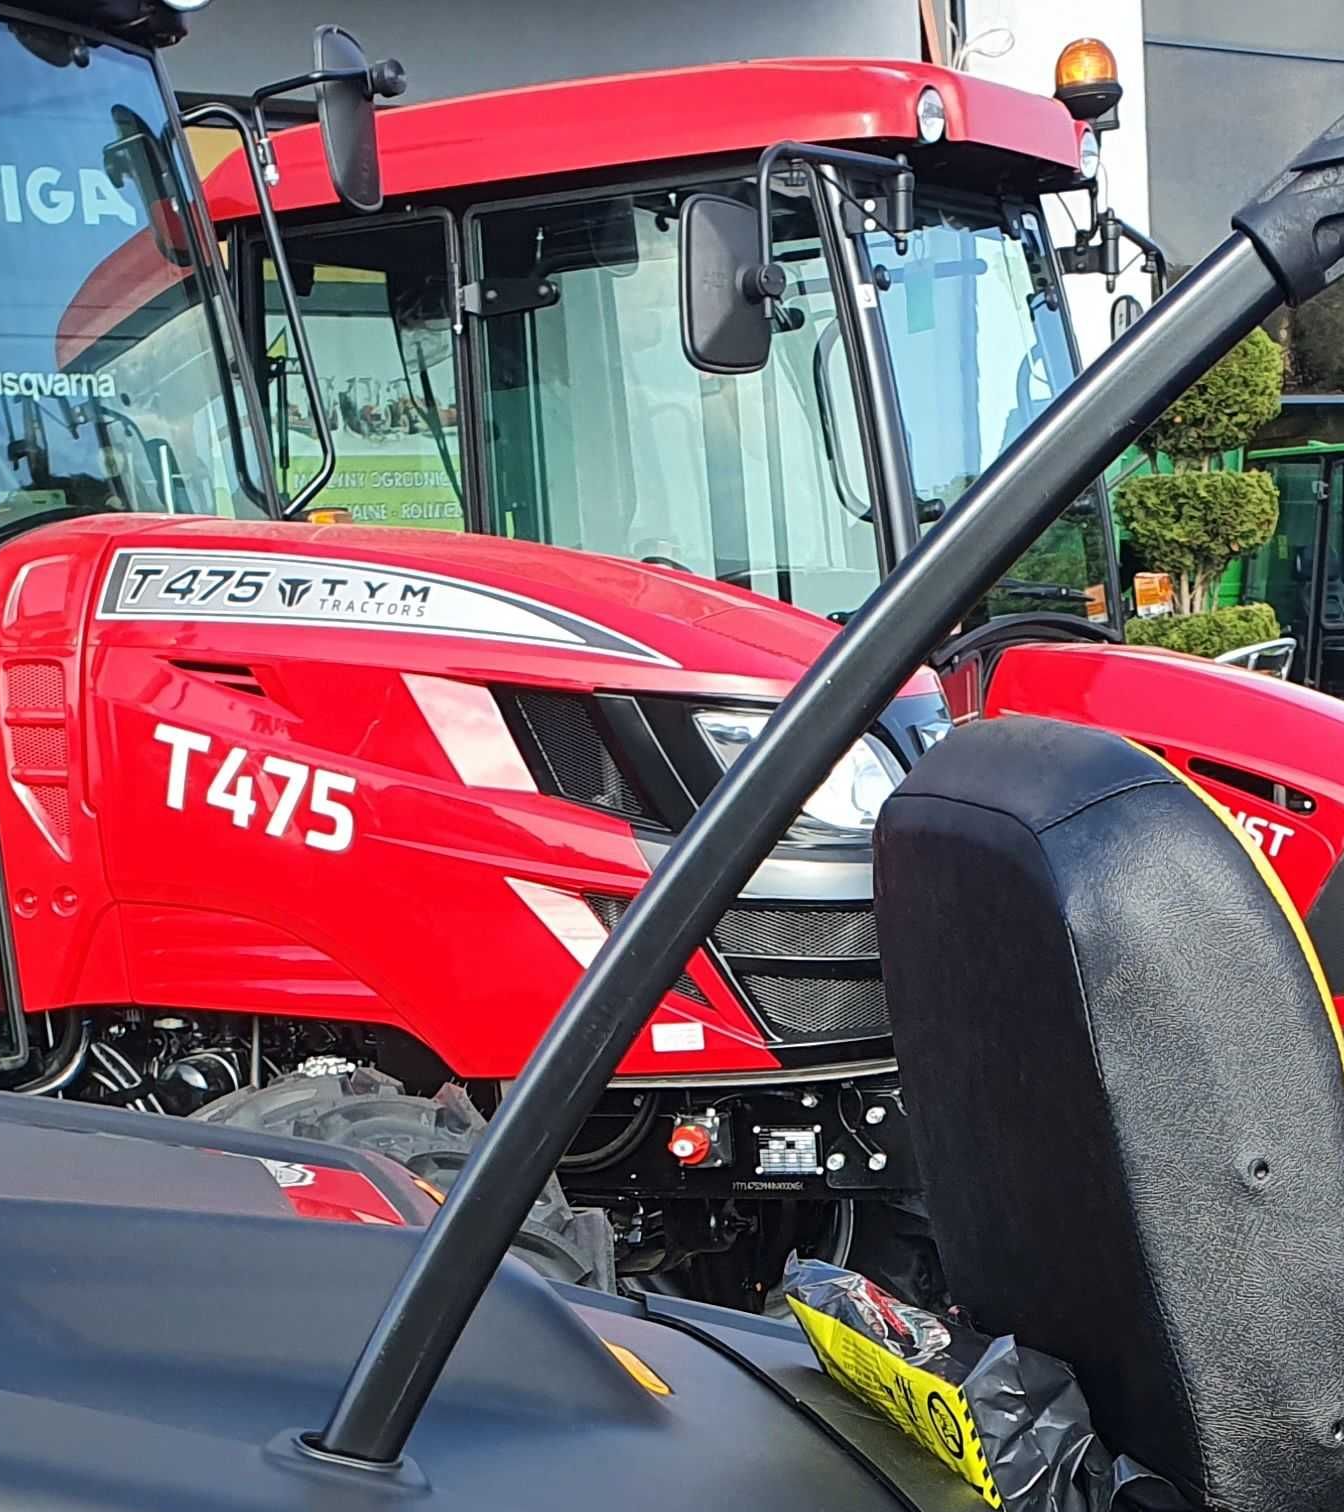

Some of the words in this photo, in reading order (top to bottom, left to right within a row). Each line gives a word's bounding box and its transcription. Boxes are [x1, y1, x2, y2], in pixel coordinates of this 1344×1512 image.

[321, 577, 431, 603] TYM
[318, 598, 427, 618] TRACTORS
[153, 722, 358, 854] T475
